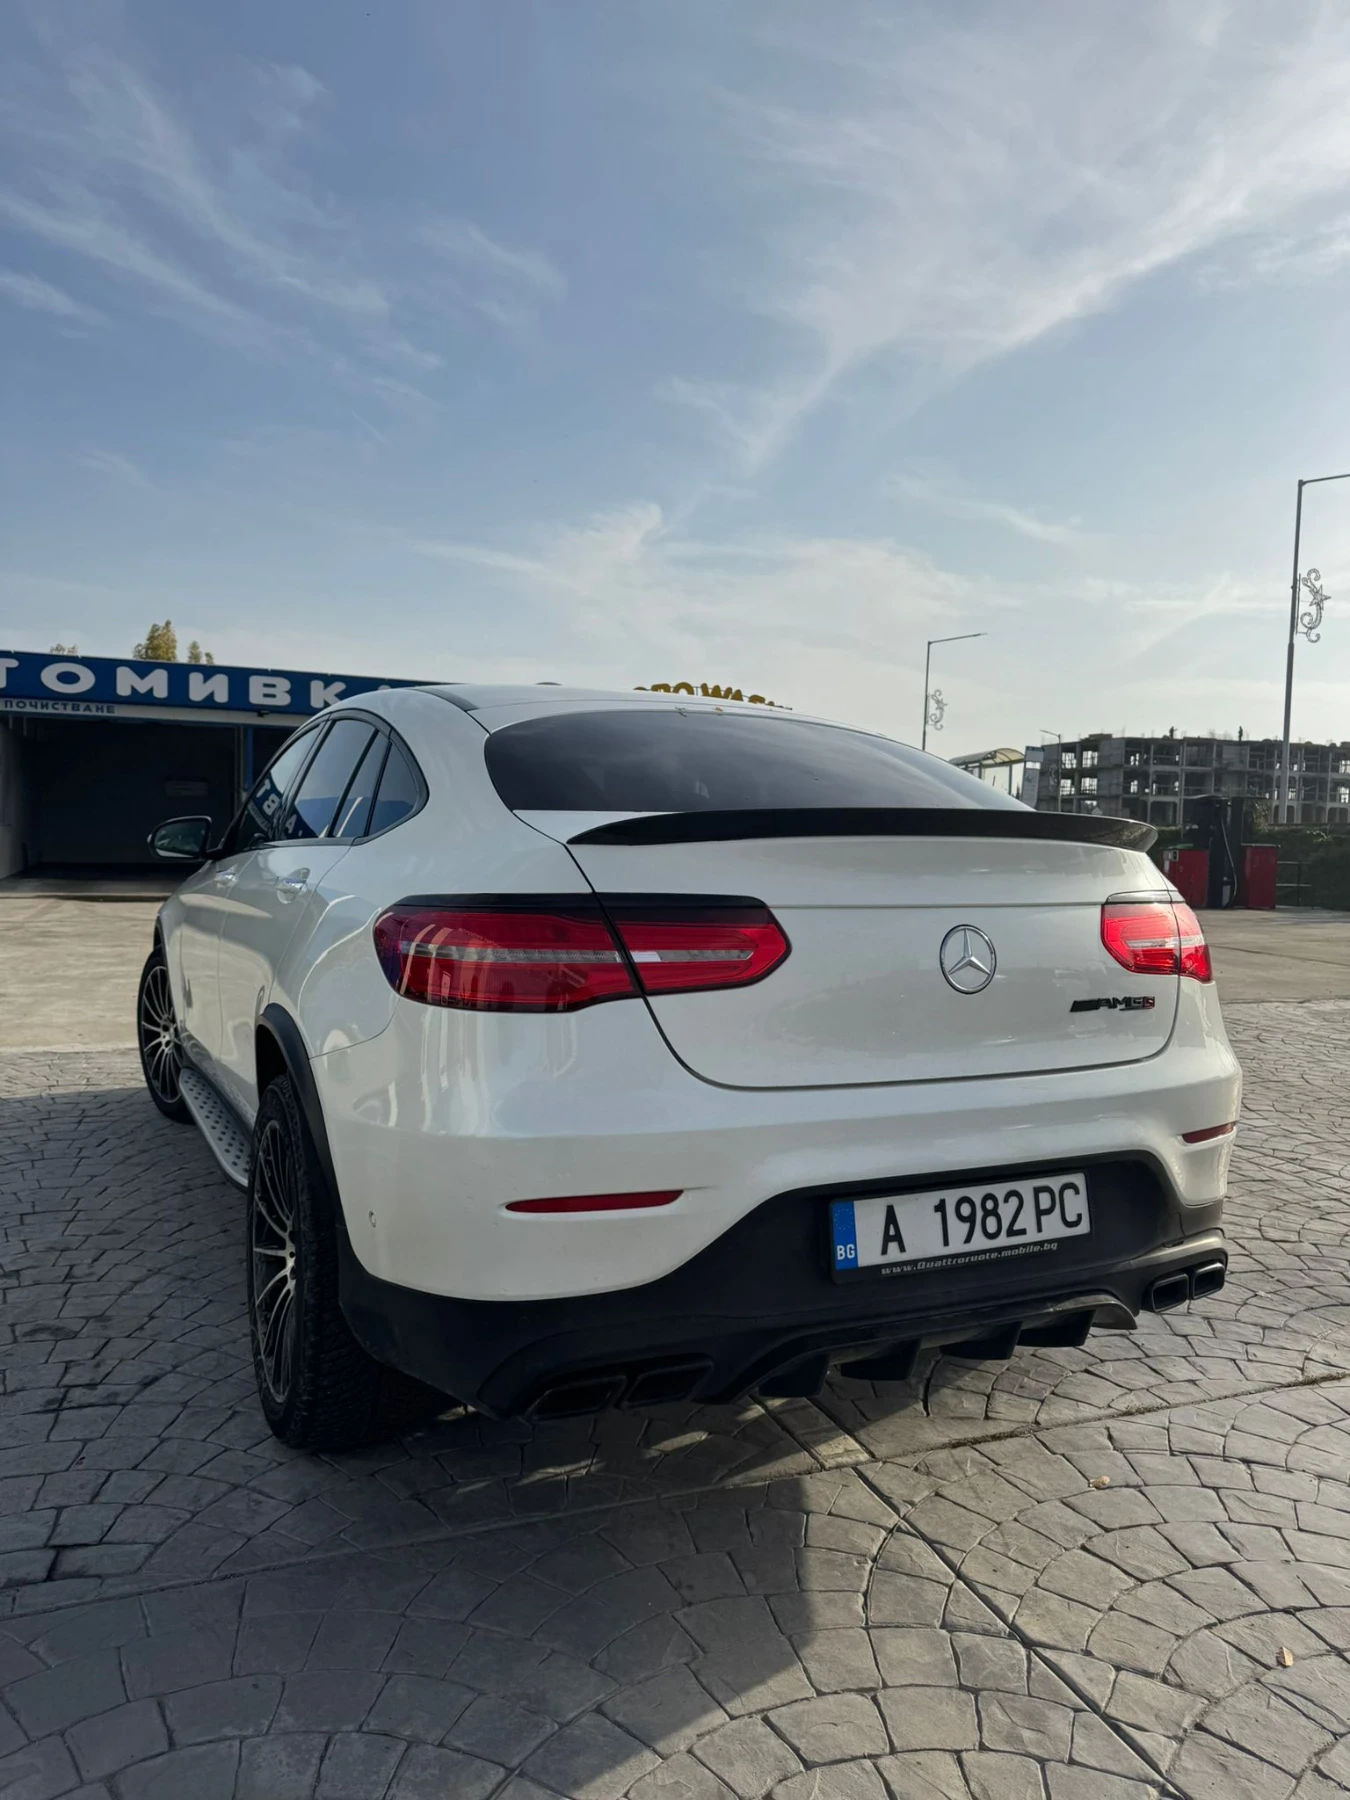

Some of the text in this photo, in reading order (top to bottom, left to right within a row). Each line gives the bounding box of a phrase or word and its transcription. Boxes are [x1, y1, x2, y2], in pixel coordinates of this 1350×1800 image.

[0, 658, 392, 708] ОМИВК
[5, 700, 116, 714] ПОЧИСТВАНЕ
[881, 1204, 907, 1256] A
[836, 1244, 856, 1261] BG
